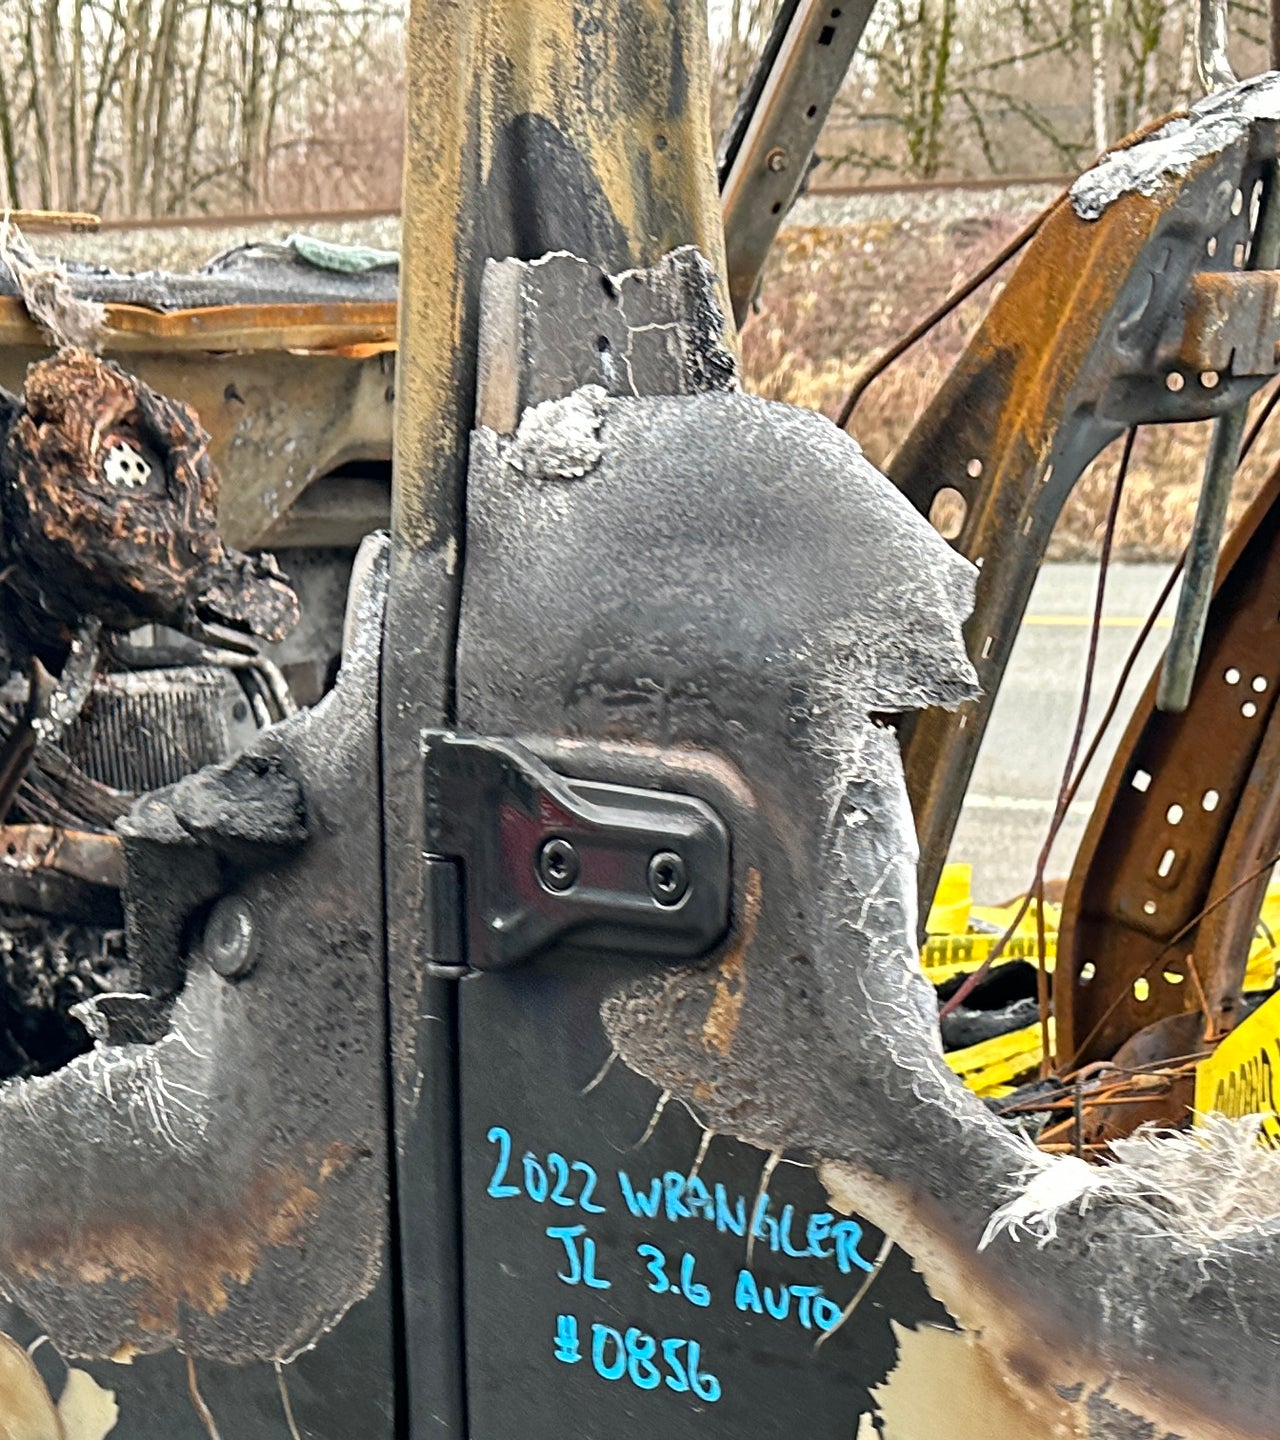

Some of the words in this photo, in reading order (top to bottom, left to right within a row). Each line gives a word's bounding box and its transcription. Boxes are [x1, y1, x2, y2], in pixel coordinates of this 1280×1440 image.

[486, 1125, 607, 1214] 2022
[618, 1170, 875, 1274] WRANGLER
[545, 1223, 611, 1290] JL
[636, 1243, 712, 1308] 3.6
[734, 1268, 844, 1332] AUTO
